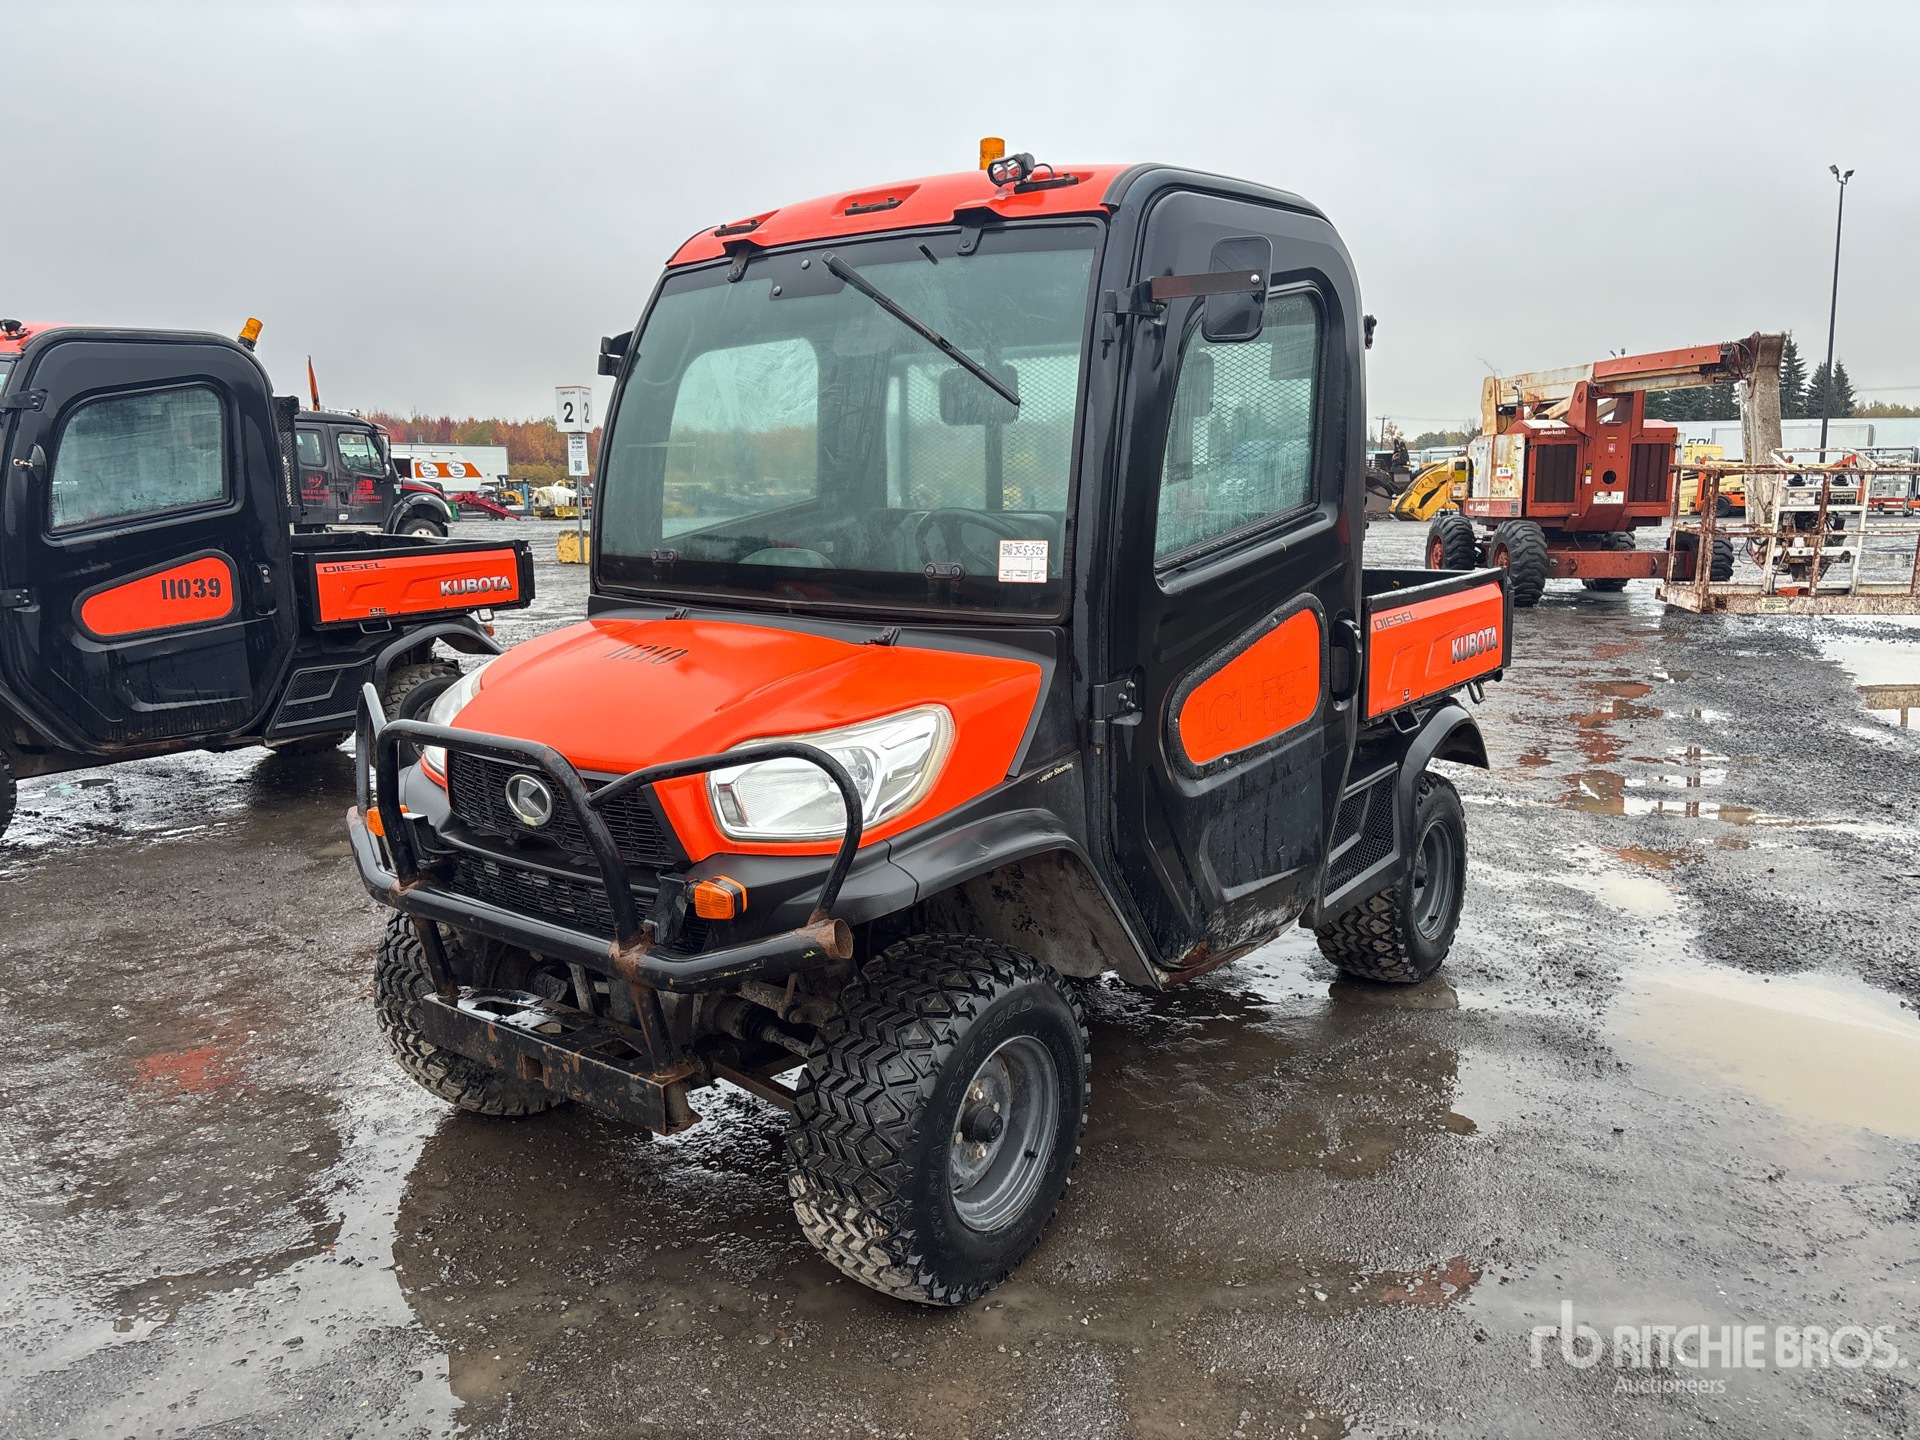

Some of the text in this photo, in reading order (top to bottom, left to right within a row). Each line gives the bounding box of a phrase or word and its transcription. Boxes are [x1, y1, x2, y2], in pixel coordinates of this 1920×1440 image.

[563, 401, 574, 423] 2
[583, 402, 590, 423] 2
[323, 563, 386, 573] DIESEL
[161, 578, 221, 599] 11039
[440, 576, 512, 596] KUBOTA
[1374, 611, 1418, 631] DIESEL
[1452, 625, 1498, 664] KUBOTA
